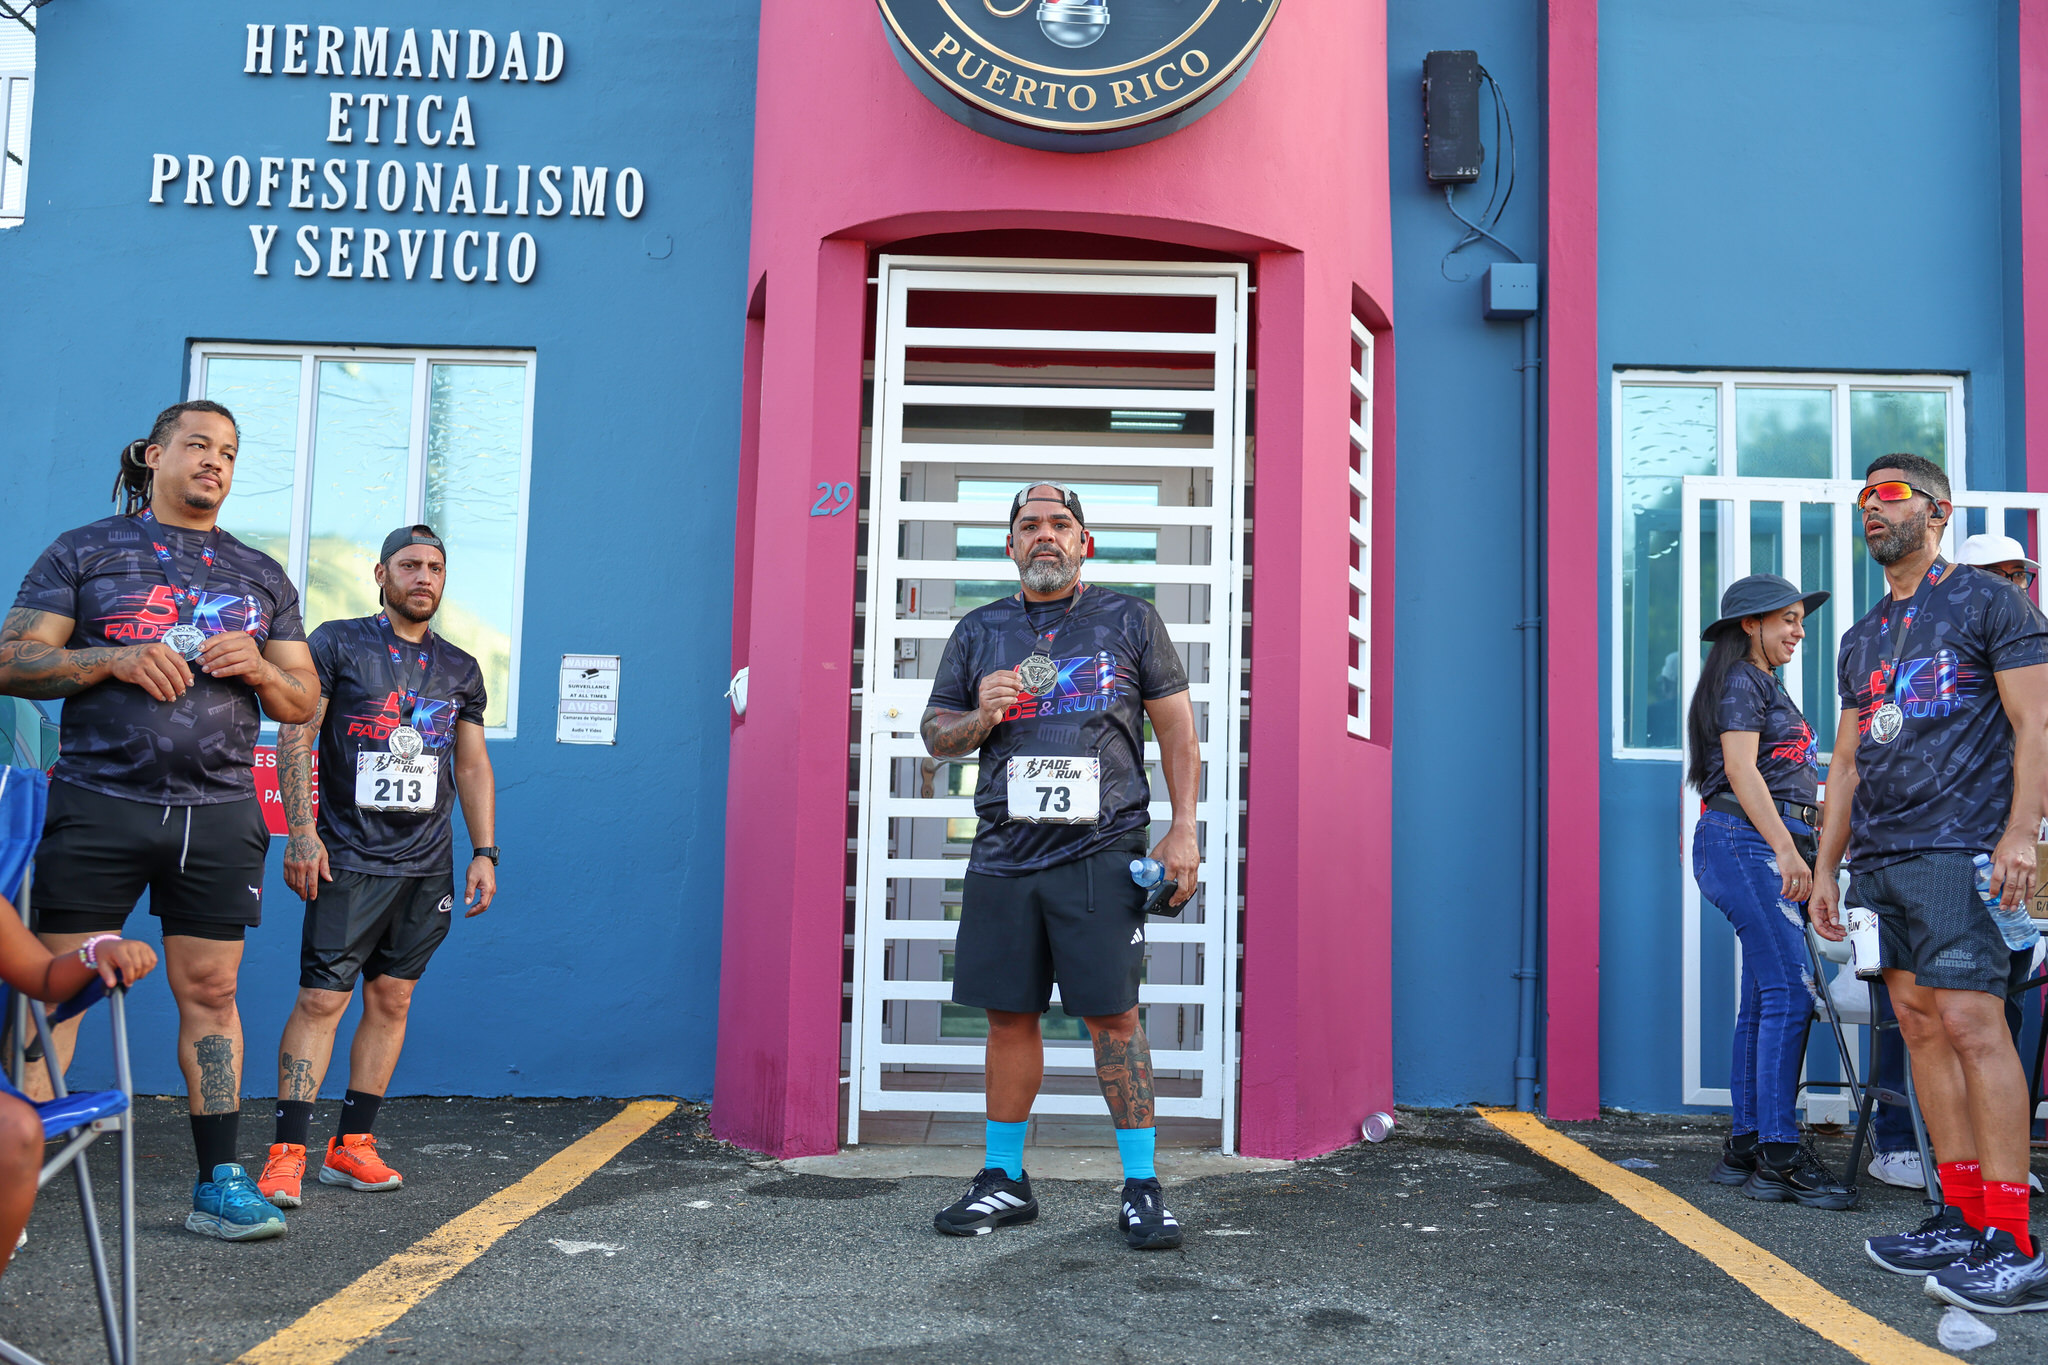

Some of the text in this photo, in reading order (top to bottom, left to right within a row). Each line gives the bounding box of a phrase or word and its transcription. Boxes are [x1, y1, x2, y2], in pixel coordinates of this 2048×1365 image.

[244, 23, 565, 82] HERMANDAD
[928, 31, 1211, 112] PUERTO RICO
[326, 91, 476, 146] ETICA
[1456, 166, 1479, 175] 325
[149, 152, 645, 220] PROFESIONALISMO
[249, 224, 538, 283] Y SERVICIO
[810, 481, 854, 517] 29
[565, 658, 616, 668] WARNING
[567, 702, 609, 712] AVISO
[1039, 701, 1054, 717] &
[1057, 695, 1109, 715] RUN
[401, 765, 424, 774] RUN
[1040, 759, 1072, 770] FADE
[1055, 770, 1082, 779] RUN
[374, 778, 422, 803] 213
[1035, 786, 1071, 813] 73
[1935, 957, 1977, 969] humans
